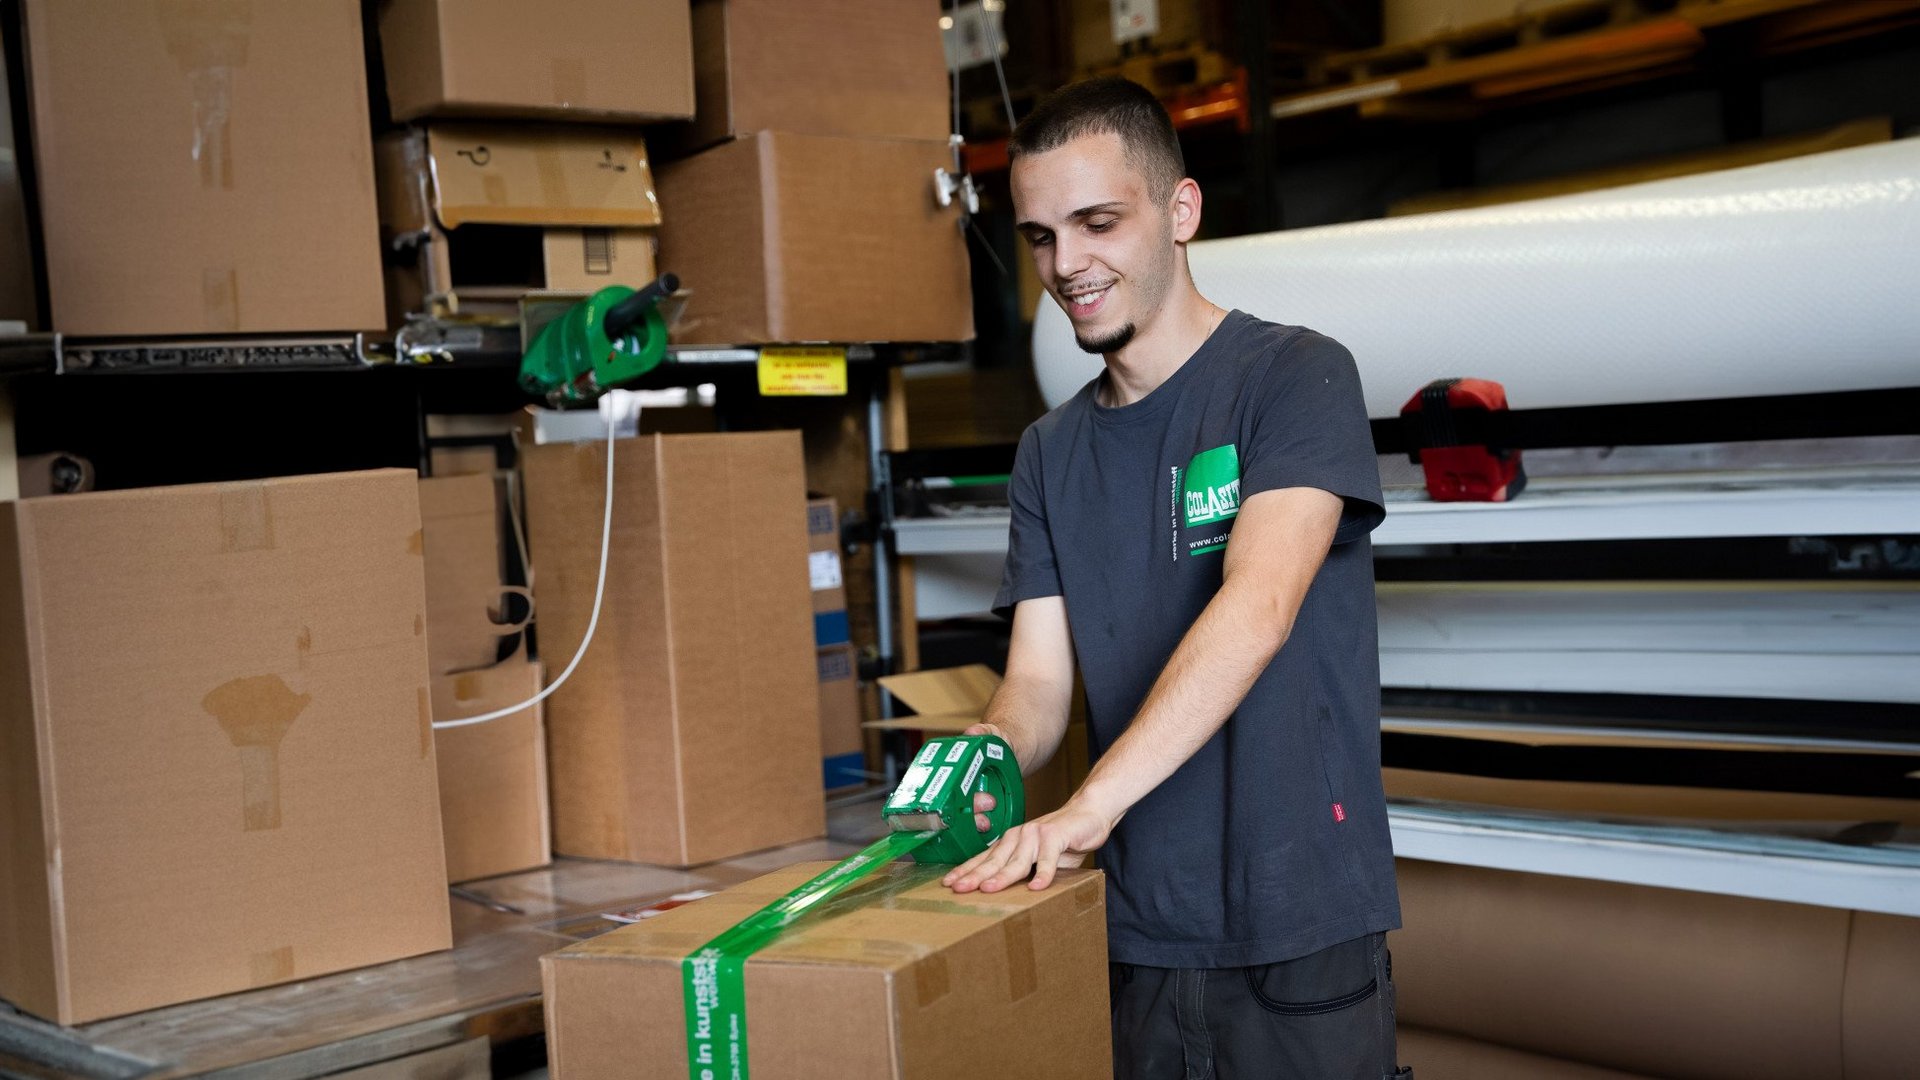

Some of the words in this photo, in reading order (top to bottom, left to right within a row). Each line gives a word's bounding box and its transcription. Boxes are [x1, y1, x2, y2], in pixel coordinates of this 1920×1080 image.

[1171, 466, 1179, 516] kunststoff
[1172, 518, 1177, 528] in
[697, 1043, 712, 1064] in
